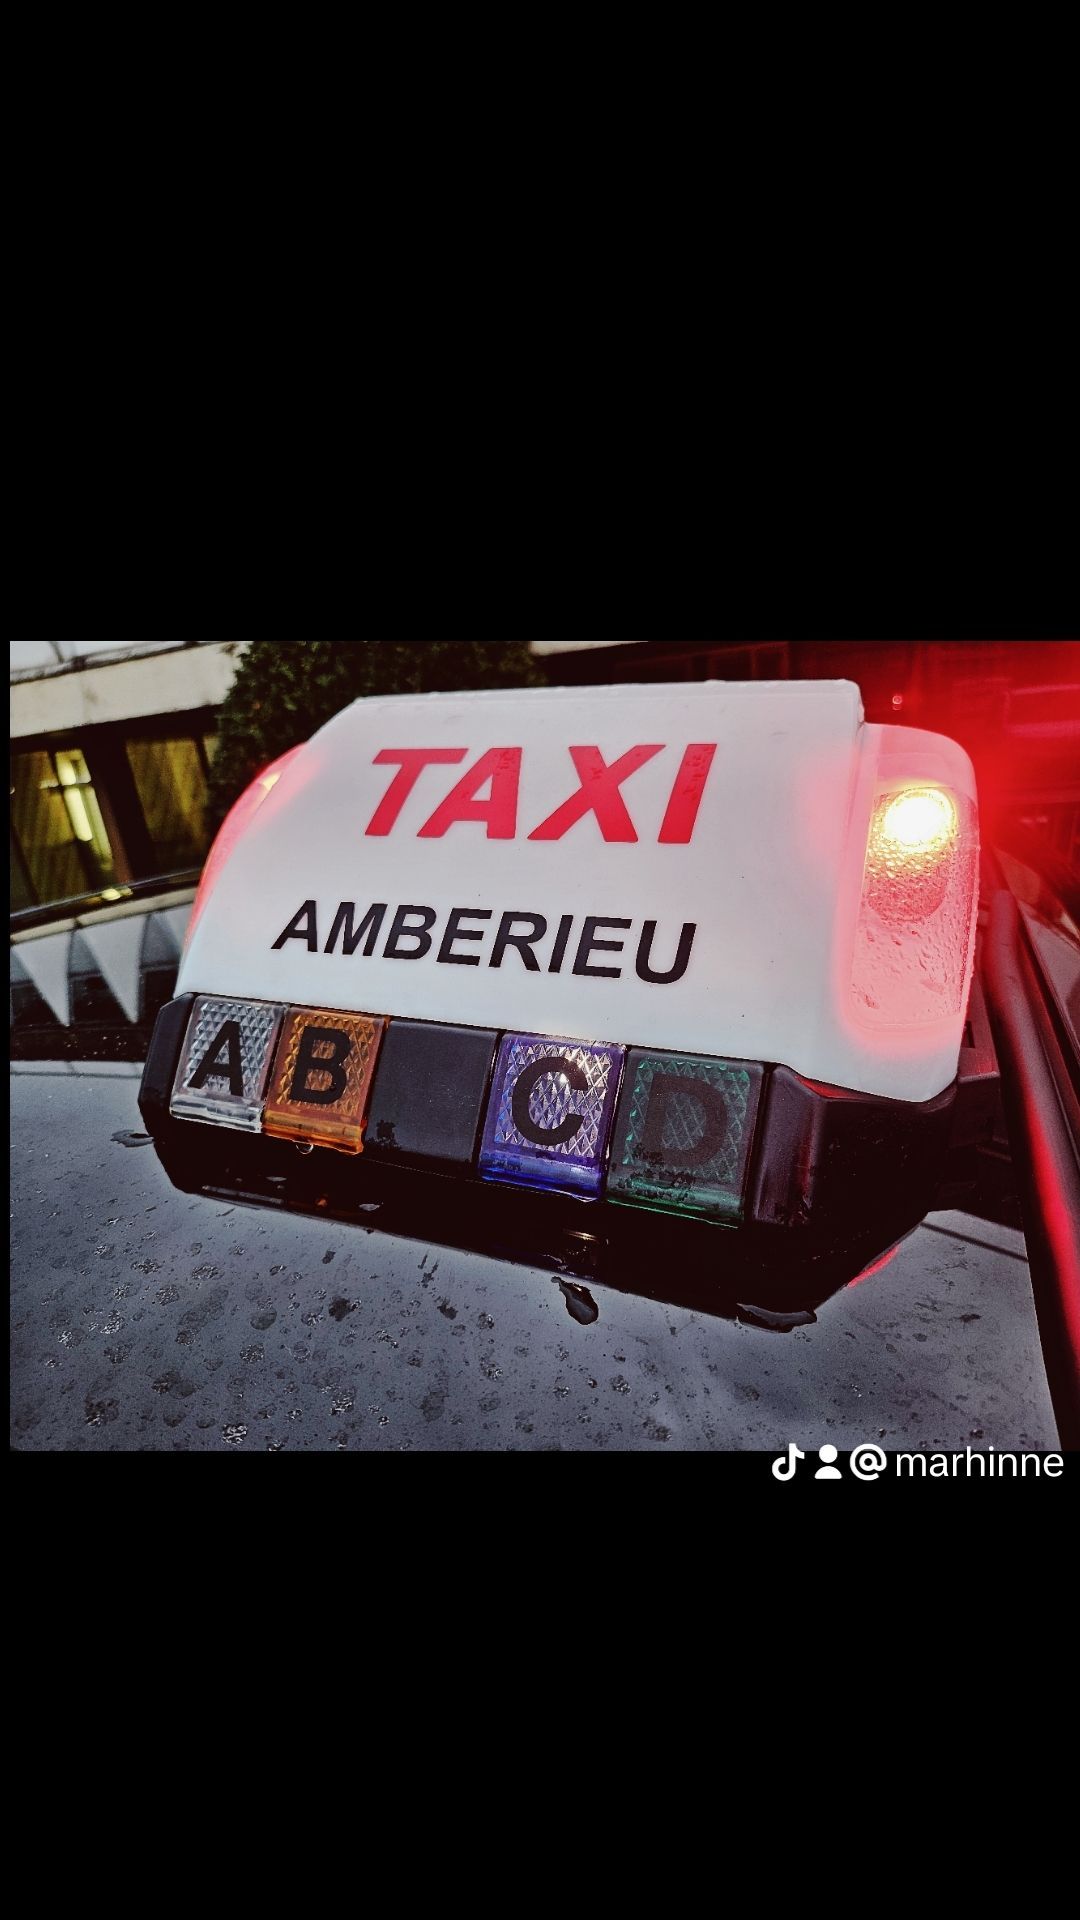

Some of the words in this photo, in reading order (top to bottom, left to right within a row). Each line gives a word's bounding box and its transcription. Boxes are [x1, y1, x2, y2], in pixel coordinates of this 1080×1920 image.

[365, 743, 717, 844] TAXI
[271, 899, 698, 985] AMBERIEU
[188, 1020, 246, 1097] A
[288, 1026, 350, 1105] B
[511, 1056, 588, 1147] C
[642, 1076, 728, 1167] D
